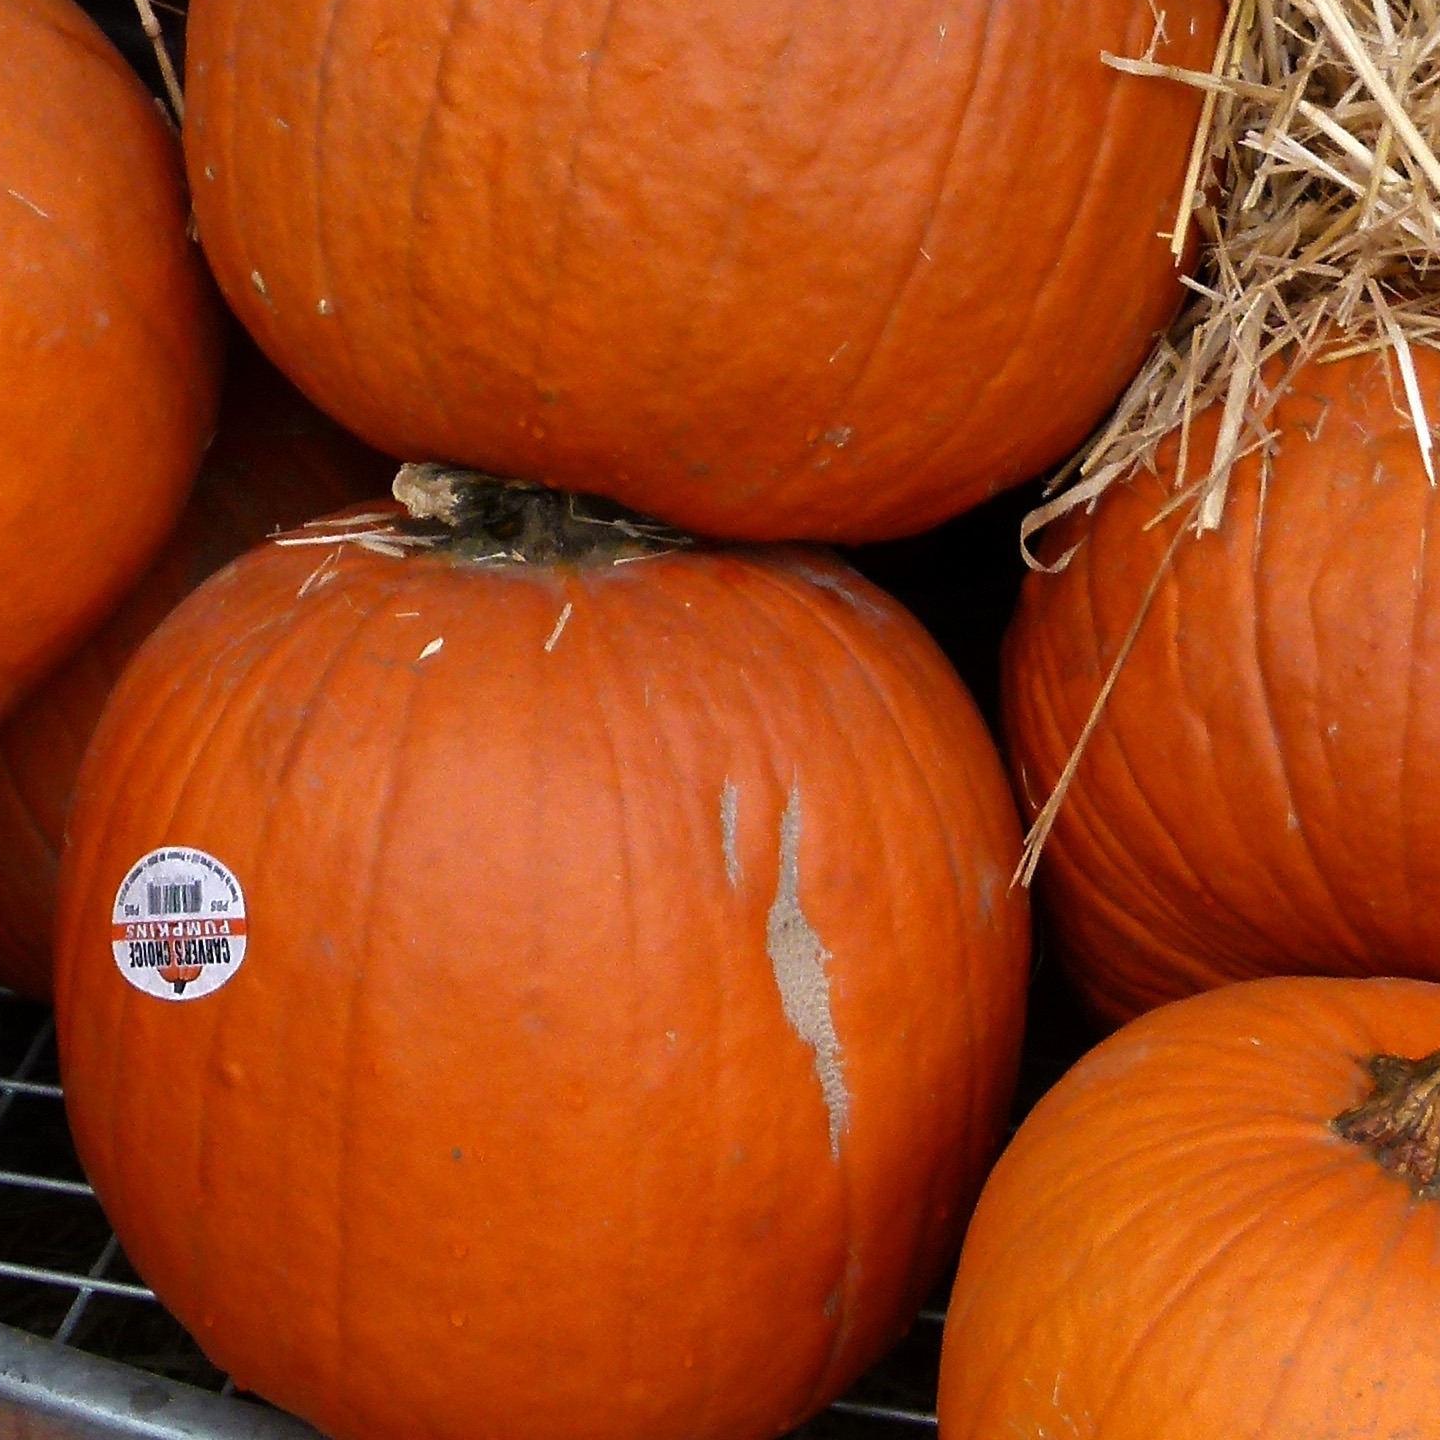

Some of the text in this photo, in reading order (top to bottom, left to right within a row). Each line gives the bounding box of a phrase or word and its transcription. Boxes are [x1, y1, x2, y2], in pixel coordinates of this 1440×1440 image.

[126, 919, 230, 939] PUMPKINS
[129, 938, 231, 968] CARVER'S CHOICE
